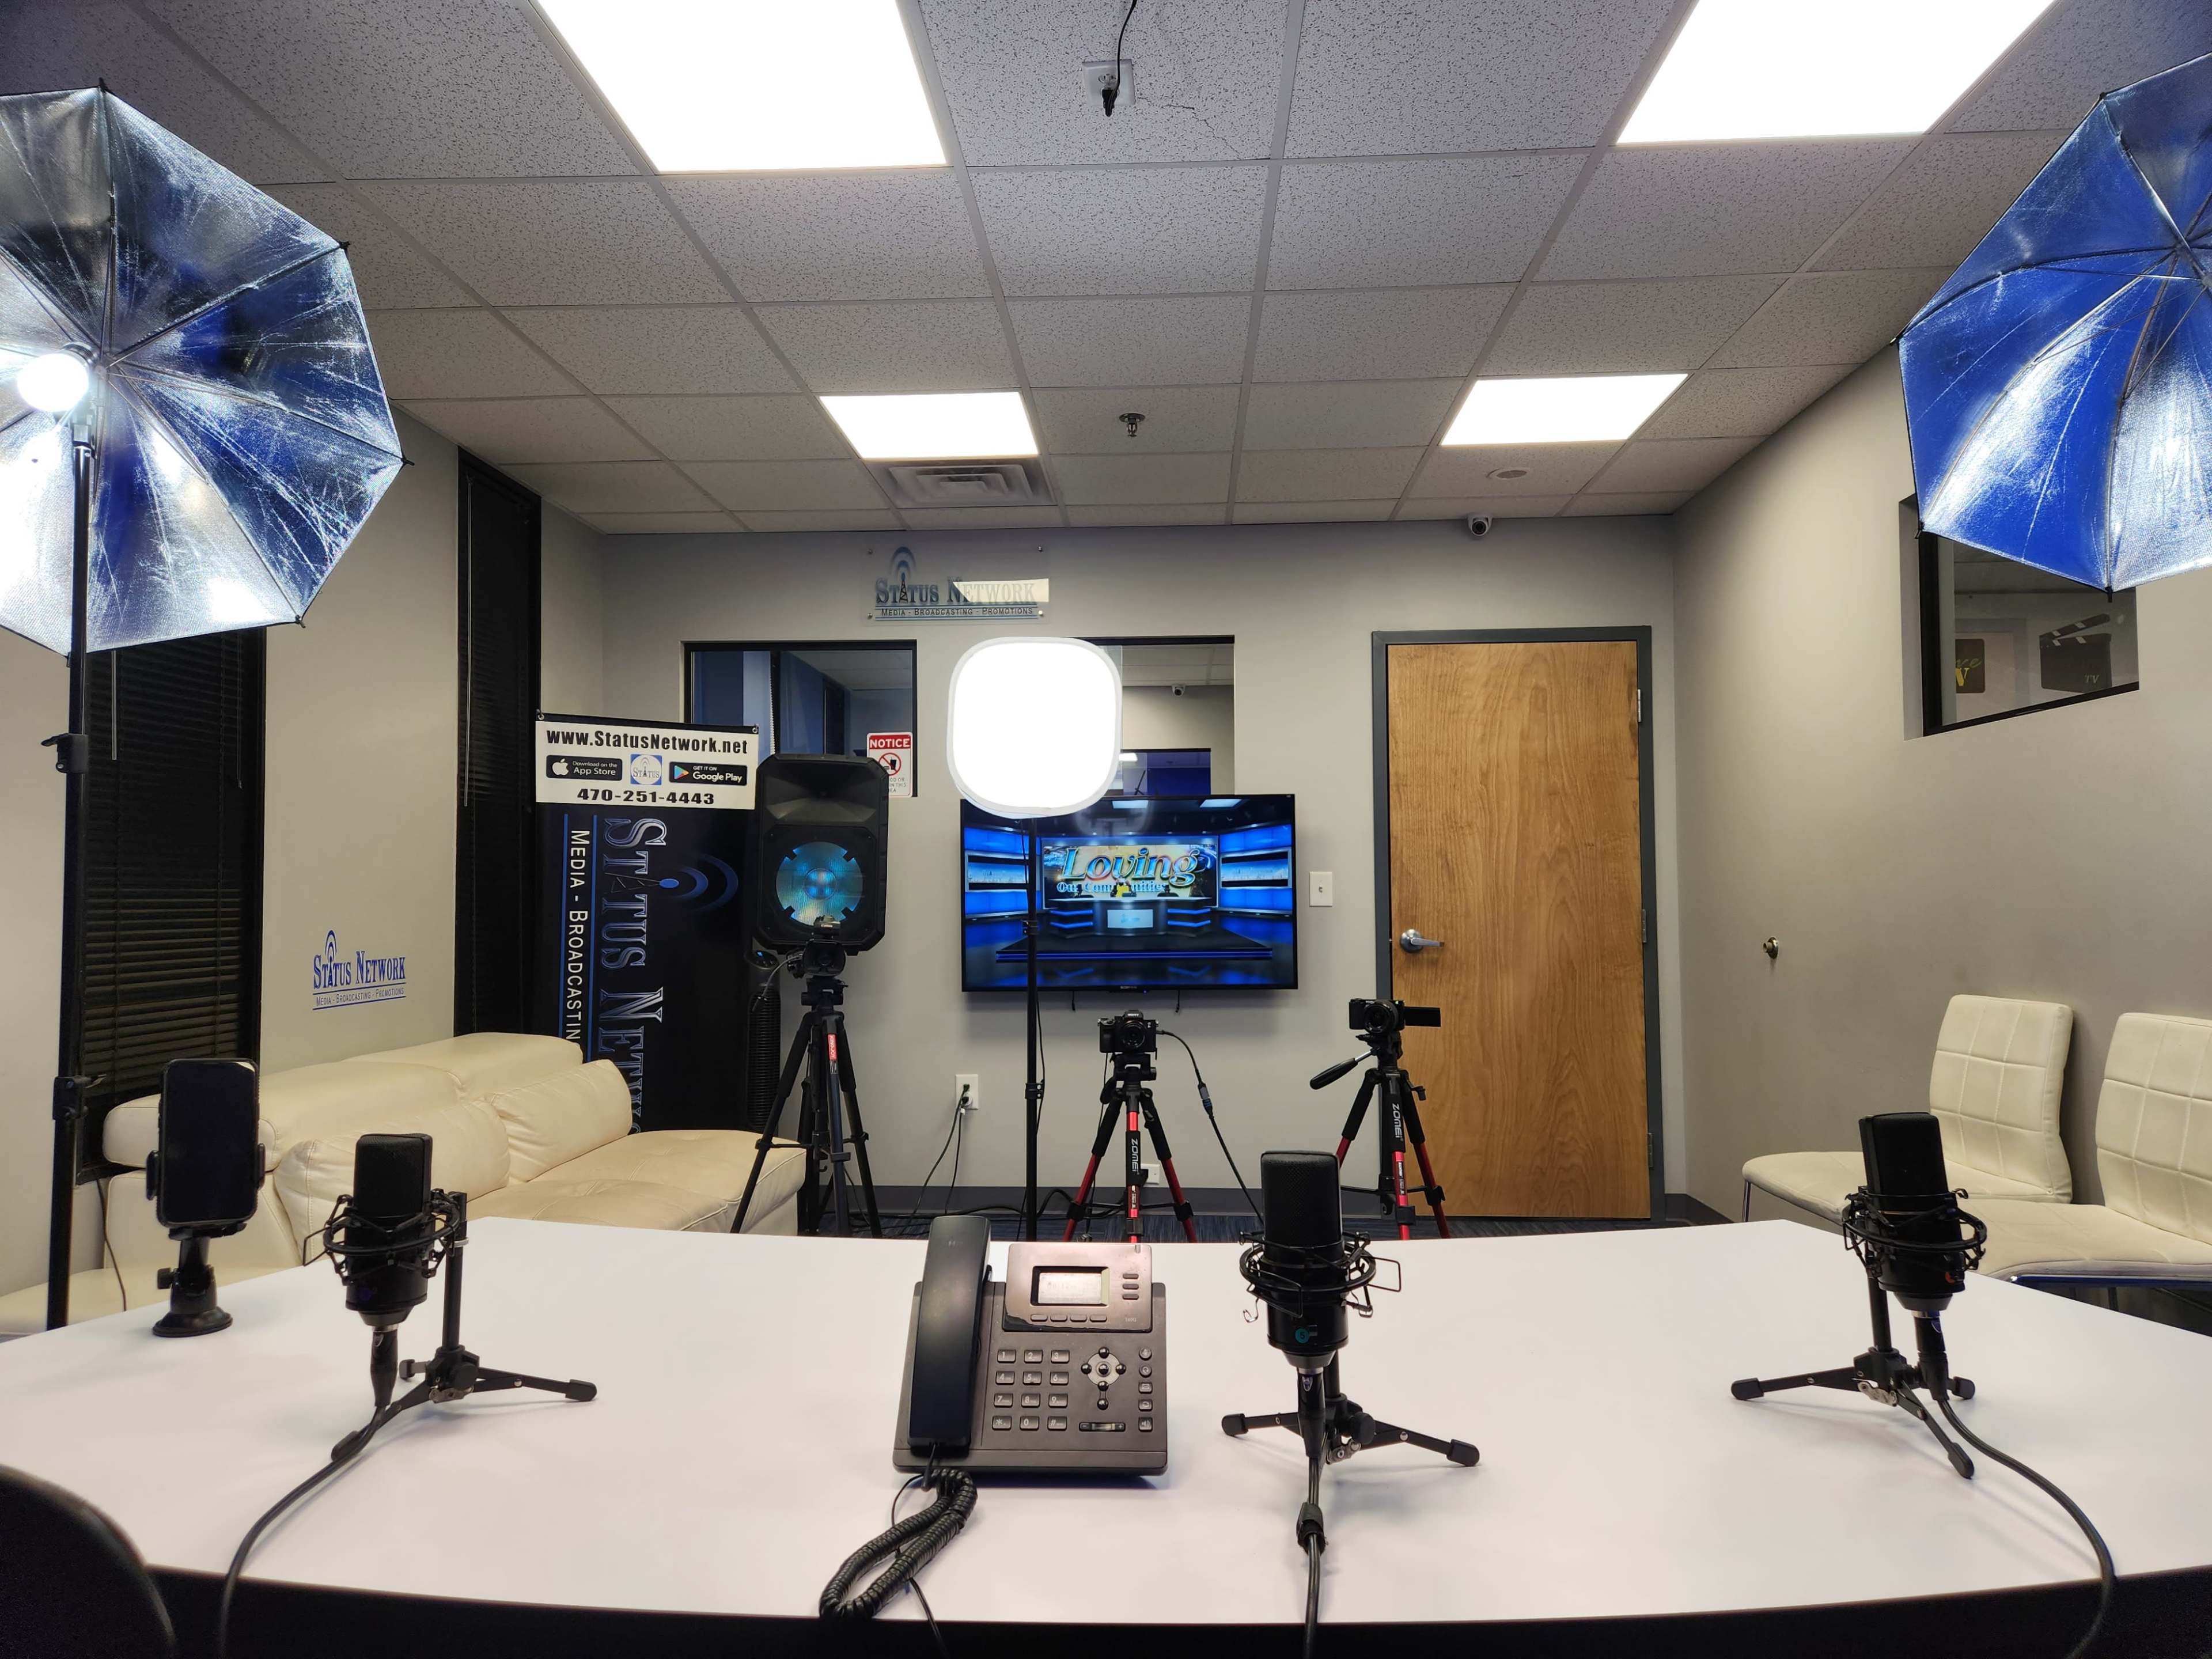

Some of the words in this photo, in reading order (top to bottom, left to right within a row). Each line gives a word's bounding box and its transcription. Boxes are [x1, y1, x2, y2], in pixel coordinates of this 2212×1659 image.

[876, 577, 939, 604] STATUS
[2085, 674, 2100, 684] TV
[546, 730, 748, 754] www.StatusNetwork.net
[870, 738, 910, 748] NOTICE
[573, 767, 592, 775] App
[593, 767, 616, 775] Store
[633, 766, 660, 778] STATUS
[692, 771, 724, 782] Google
[725, 773, 743, 783] Play
[577, 788, 714, 805] 470-251-4443
[570, 830, 590, 888] MEDIA
[1062, 847, 1200, 887] Loving
[601, 817, 668, 969] STATUS
[313, 954, 351, 990] STATUS
[355, 950, 406, 984] NETWORK
[566, 910, 589, 1040] BROADCASTIN
[316, 996, 332, 1006] MEDIA
[336, 991, 371, 1003] BROADCASTING
[376, 987, 404, 998] PROMOTIONS
[1051, 1396, 1056, 1404] 9
[1023, 1418, 1029, 1426] 0
